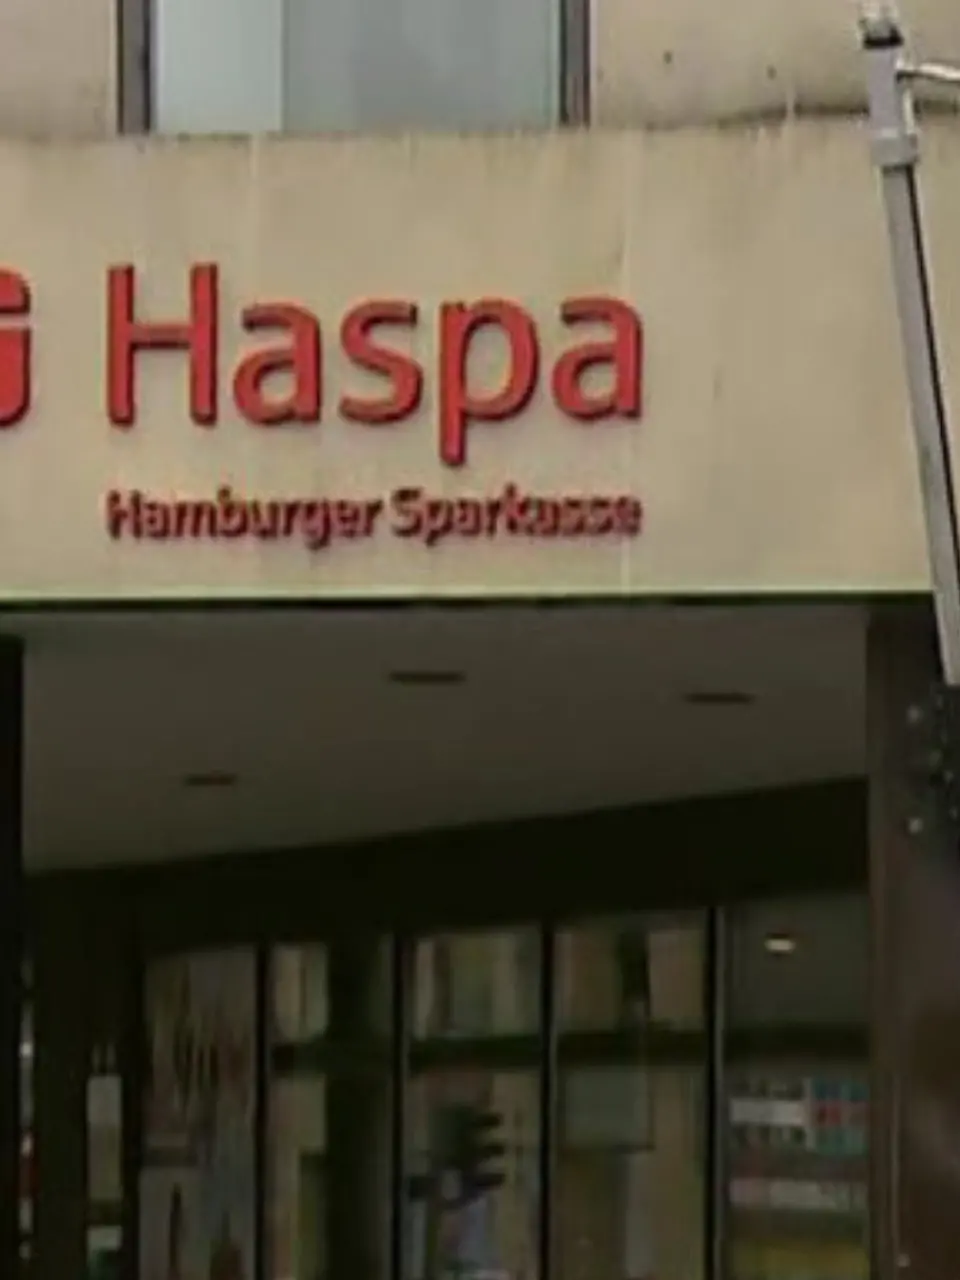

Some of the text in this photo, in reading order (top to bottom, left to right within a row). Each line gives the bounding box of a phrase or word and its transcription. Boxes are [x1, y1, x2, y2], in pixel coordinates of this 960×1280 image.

[107, 261, 644, 467] Haspa
[106, 485, 643, 549] Hamburger Sparkasse
